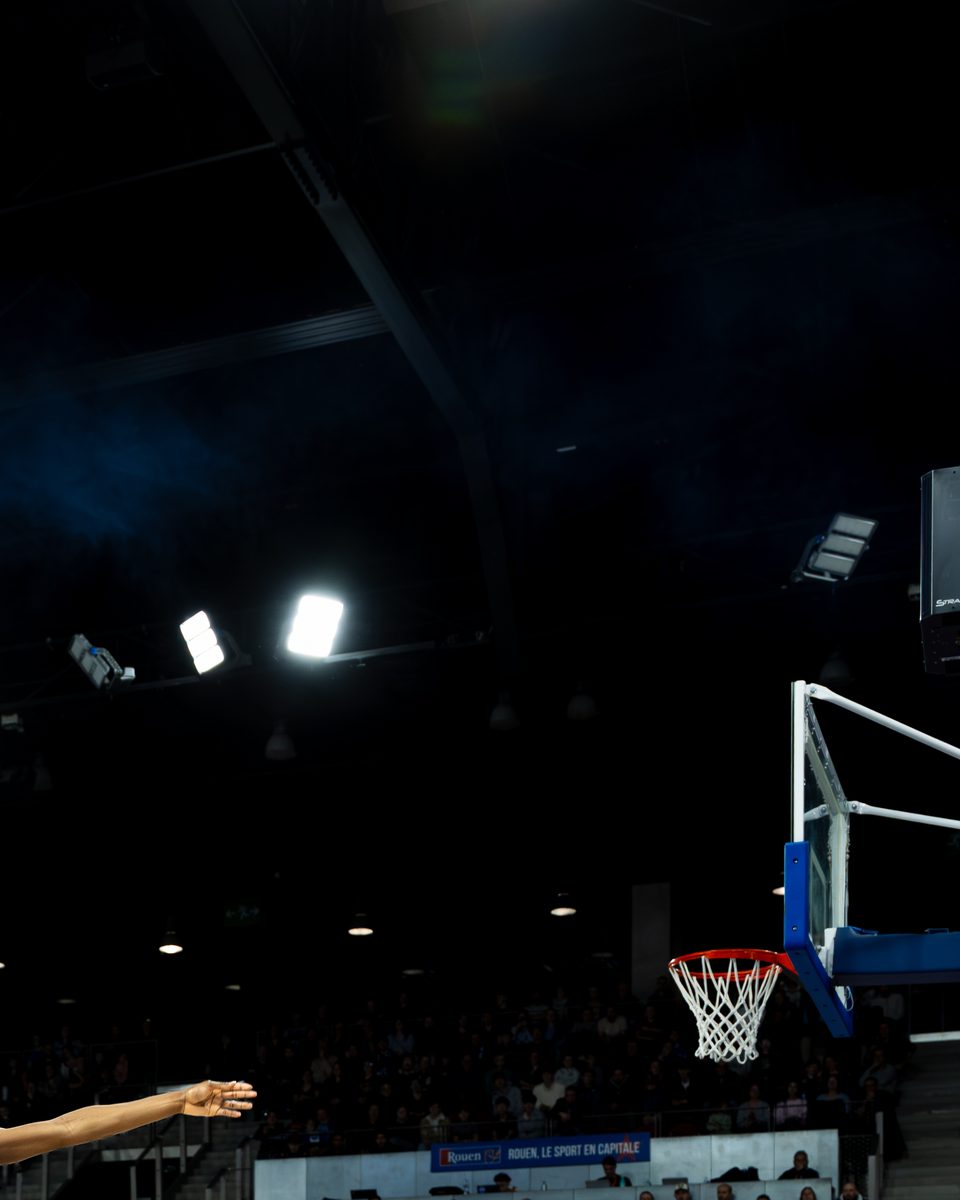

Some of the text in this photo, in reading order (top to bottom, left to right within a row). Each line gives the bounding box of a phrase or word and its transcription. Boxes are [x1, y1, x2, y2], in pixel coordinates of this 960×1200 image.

[447, 1150, 482, 1164] Rouen
[508, 1141, 641, 1161] ROUEN, LE SPORT EN CAPITALE
